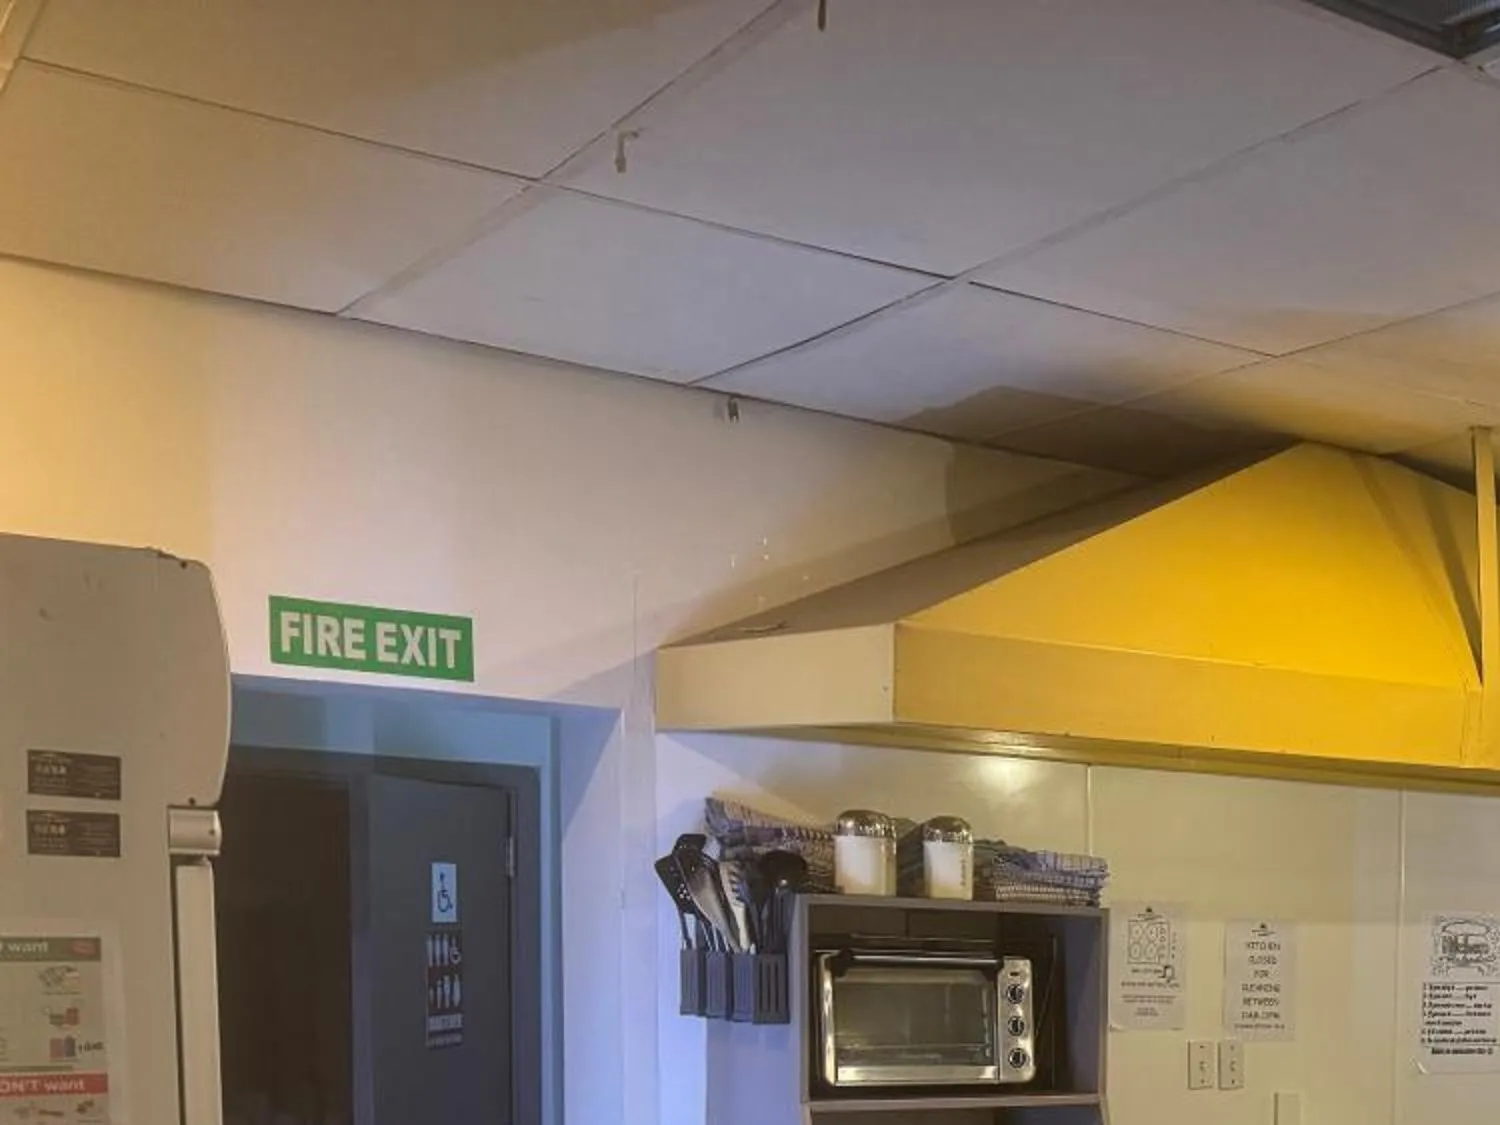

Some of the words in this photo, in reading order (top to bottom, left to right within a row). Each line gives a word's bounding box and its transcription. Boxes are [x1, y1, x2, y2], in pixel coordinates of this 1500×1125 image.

[280, 611, 367, 661] FIRE
[375, 621, 462, 669] EXIT
[0, 1079, 40, 1093] ON'T
[44, 1076, 86, 1091] want
